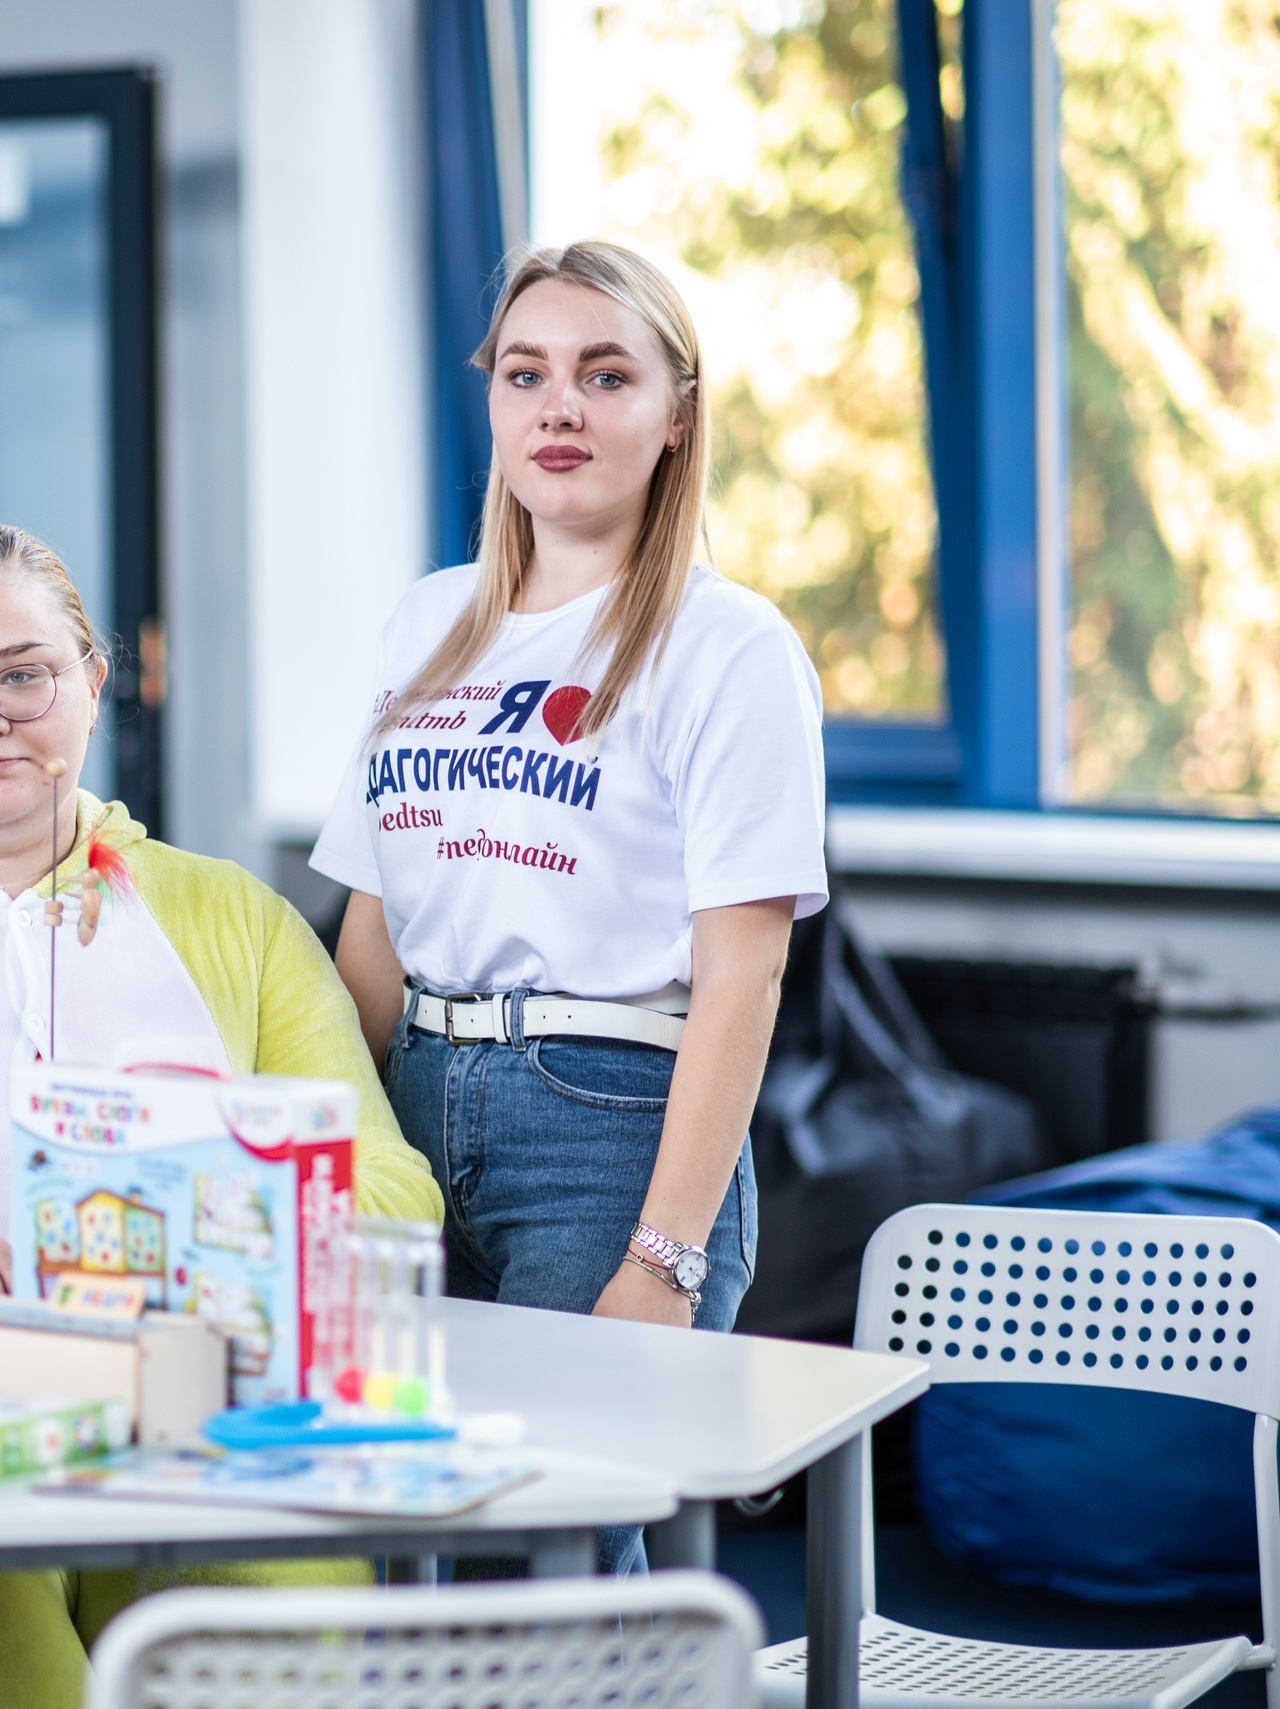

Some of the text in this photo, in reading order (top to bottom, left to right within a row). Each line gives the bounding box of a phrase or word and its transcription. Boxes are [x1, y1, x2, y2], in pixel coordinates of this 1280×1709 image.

[476, 680, 552, 735] Я
[366, 745, 601, 811] ДАГОГИЧЕСКИЙ
[378, 802, 443, 832] edtsu
